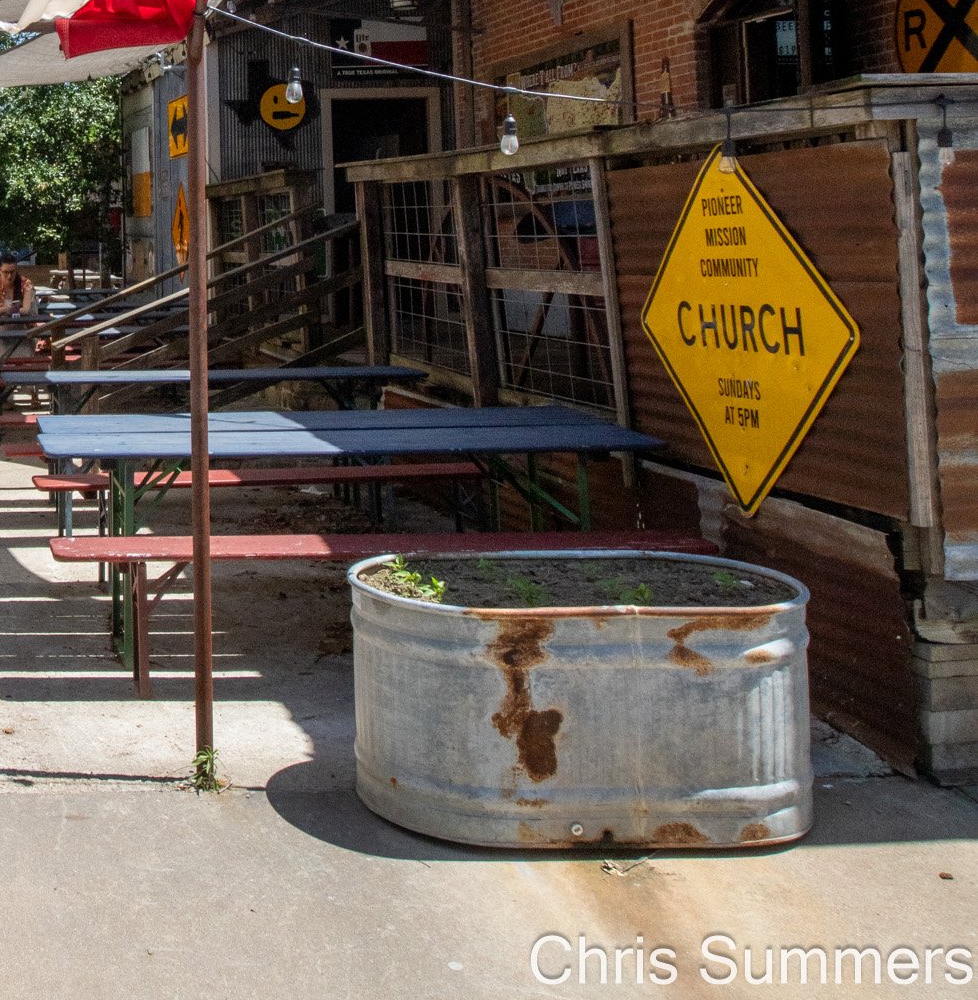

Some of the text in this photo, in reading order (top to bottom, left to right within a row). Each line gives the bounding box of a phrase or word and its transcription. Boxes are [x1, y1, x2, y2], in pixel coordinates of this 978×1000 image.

[701, 195, 743, 217] PIONEER
[705, 226, 747, 247] MISSION
[699, 258, 758, 278] COMMUNITY
[677, 300, 805, 357] CHURCH
[717, 377, 761, 401] SUNDAYS
[725, 405, 760, 429] AT 5PM
